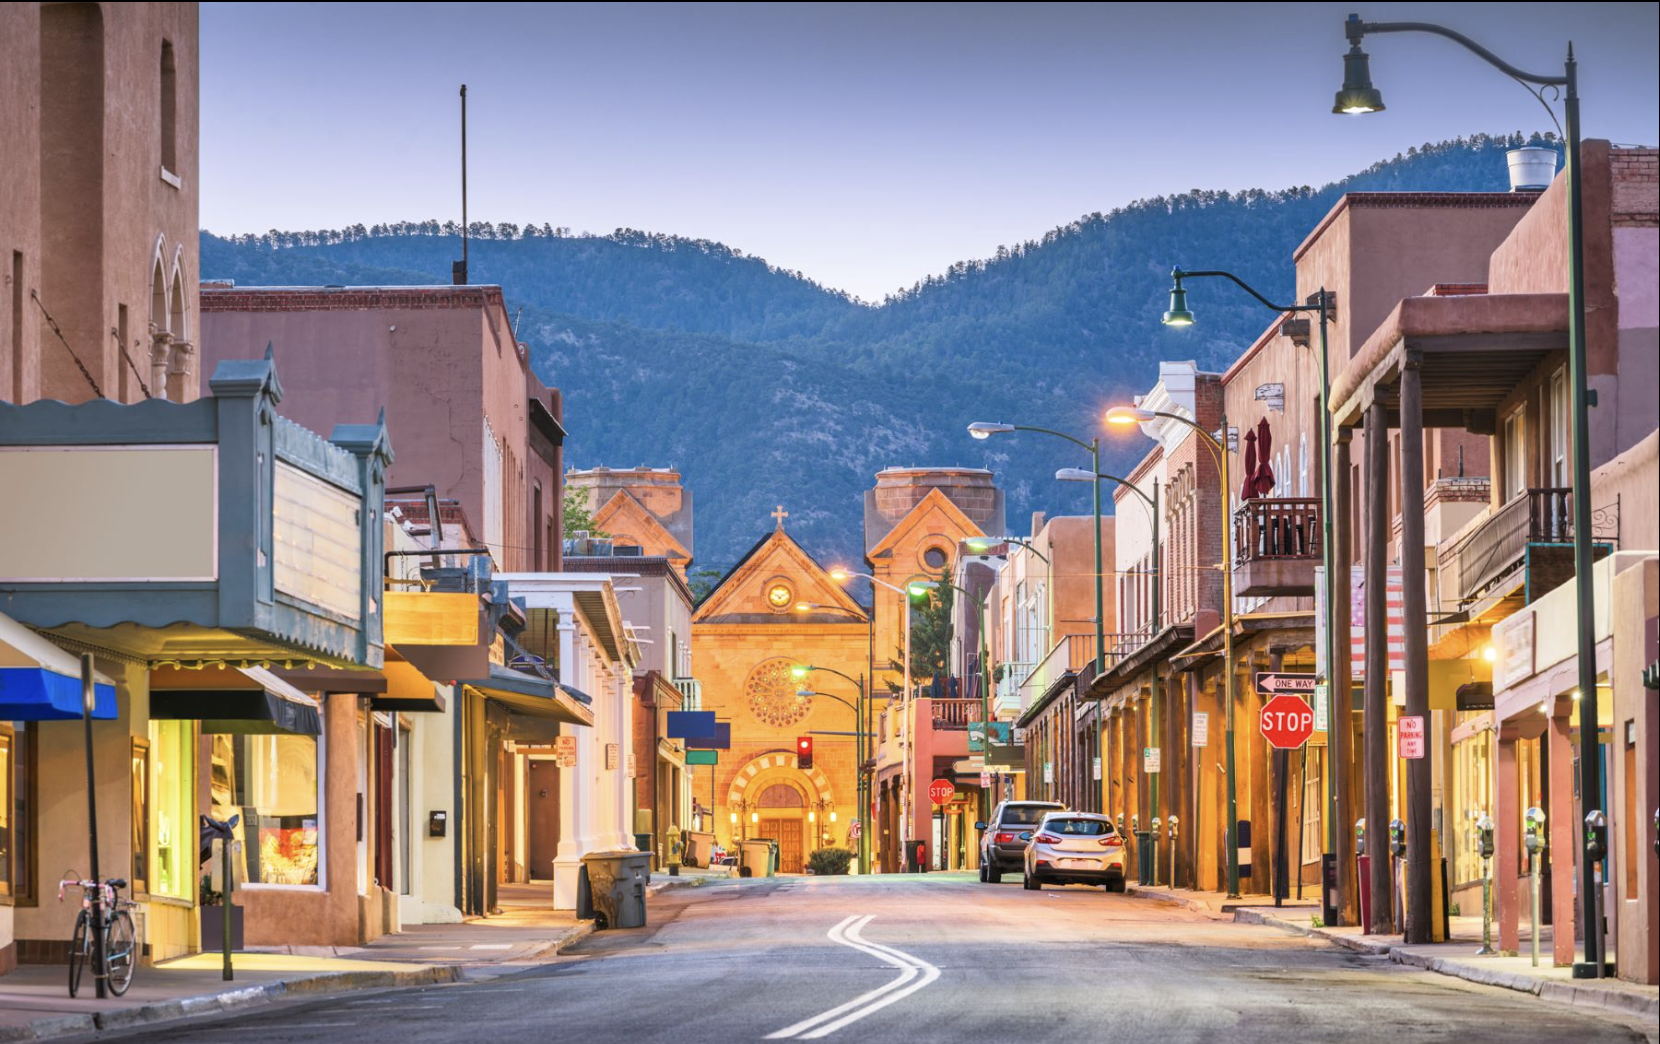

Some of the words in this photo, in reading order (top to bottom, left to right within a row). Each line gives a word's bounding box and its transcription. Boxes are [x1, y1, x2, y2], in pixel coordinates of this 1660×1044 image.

[1275, 679, 1292, 688] ONE
[1295, 679, 1313, 688] WAY
[1262, 711, 1312, 732] STOP
[1406, 721, 1416, 729] NO
[930, 787, 953, 797] STOP
